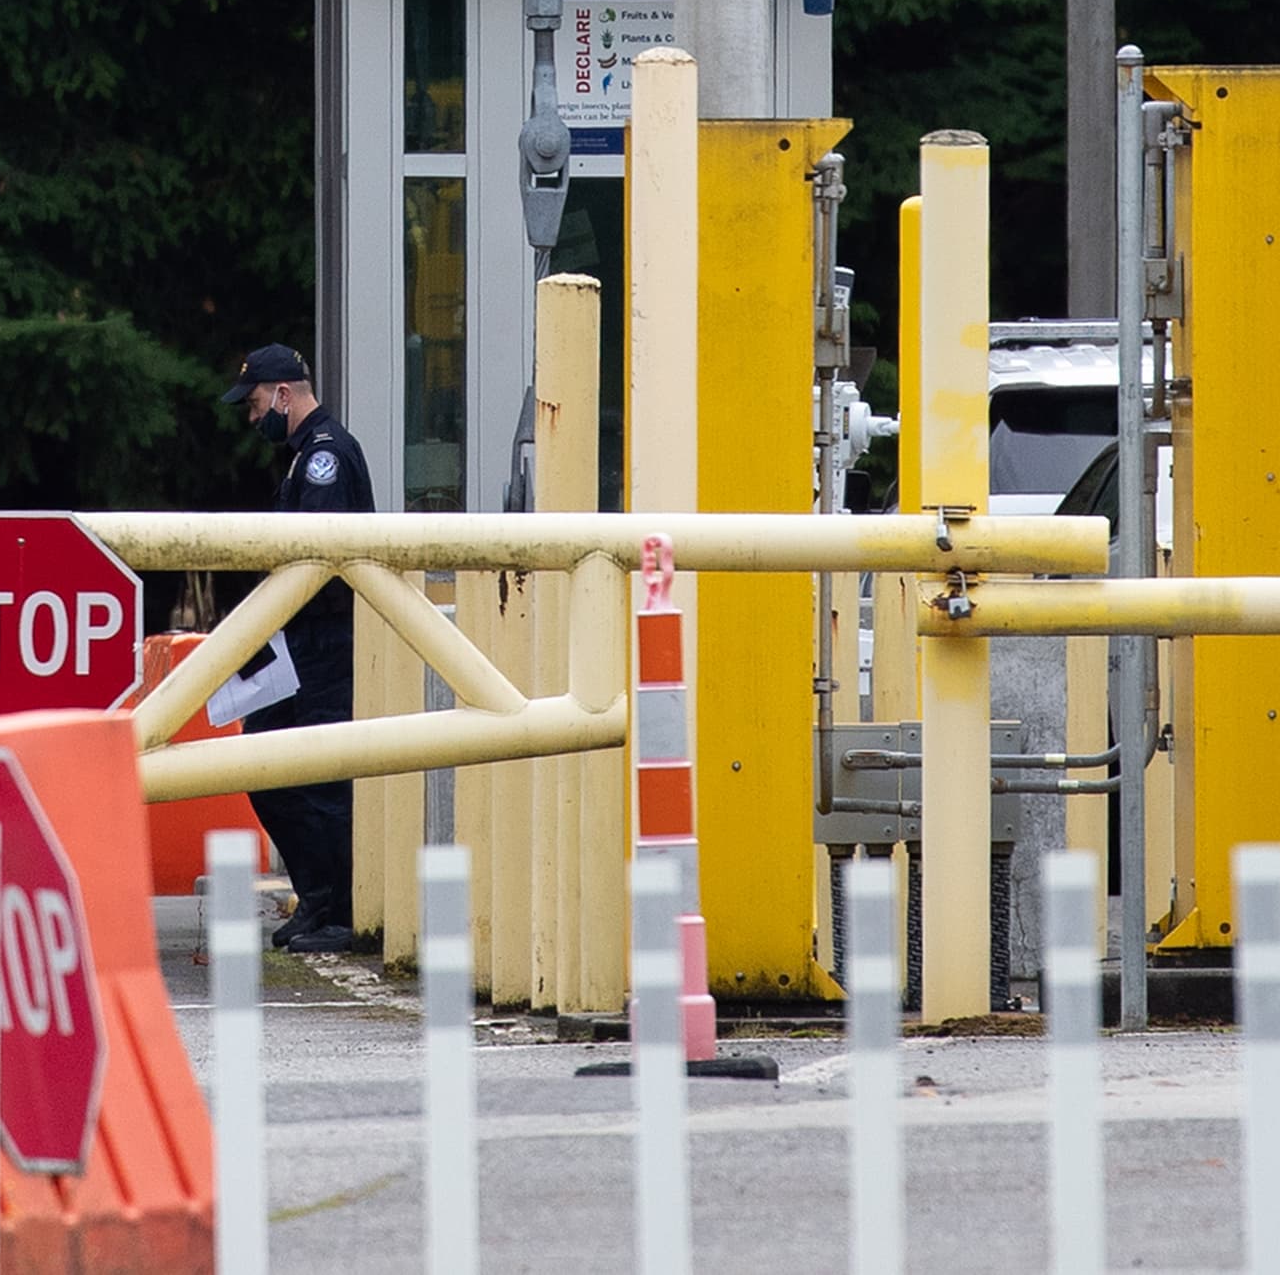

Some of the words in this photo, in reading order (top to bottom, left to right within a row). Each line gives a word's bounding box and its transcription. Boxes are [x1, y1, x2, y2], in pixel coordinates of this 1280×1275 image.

[621, 11, 647, 20] Fruits
[651, 11, 659, 20] &
[576, 8, 590, 93] DECLARE
